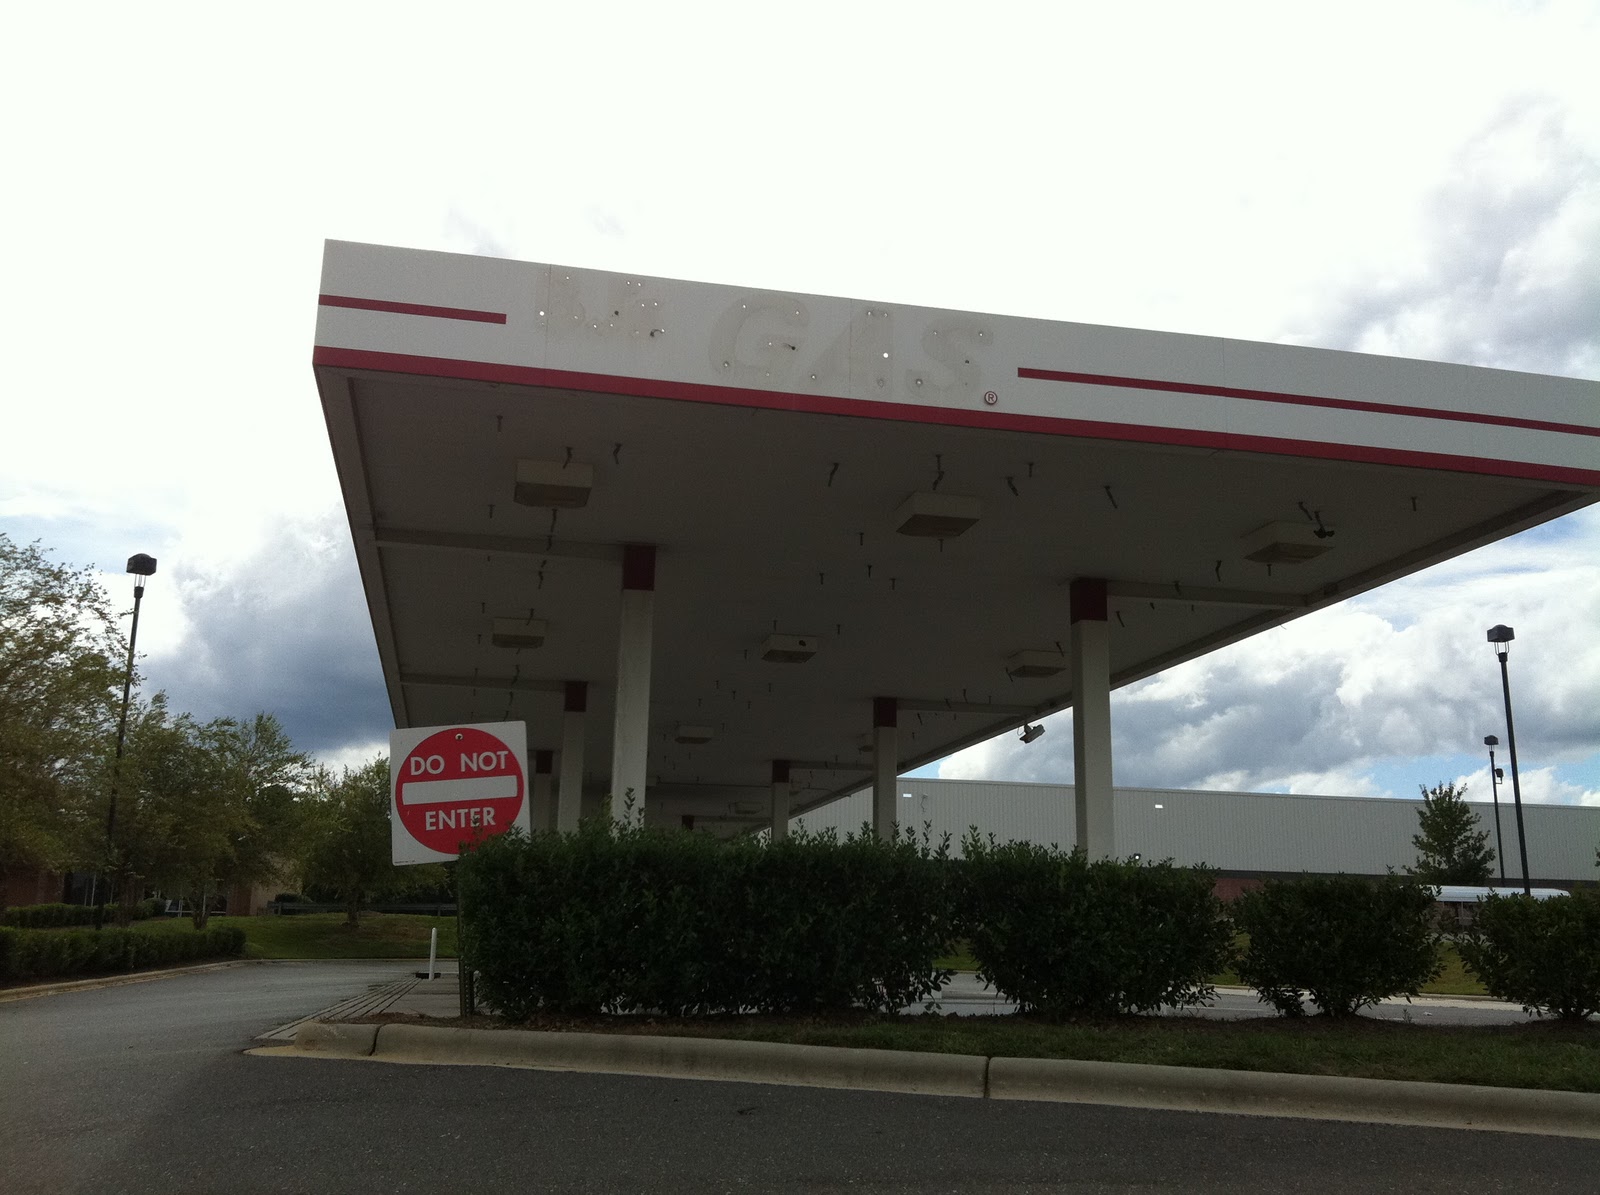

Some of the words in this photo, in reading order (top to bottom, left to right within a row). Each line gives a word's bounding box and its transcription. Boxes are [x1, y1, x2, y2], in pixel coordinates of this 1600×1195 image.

[708, 293, 994, 397] GAS
[410, 755, 445, 776] DO
[460, 751, 509, 772] NOT
[425, 807, 496, 831] ENTER
